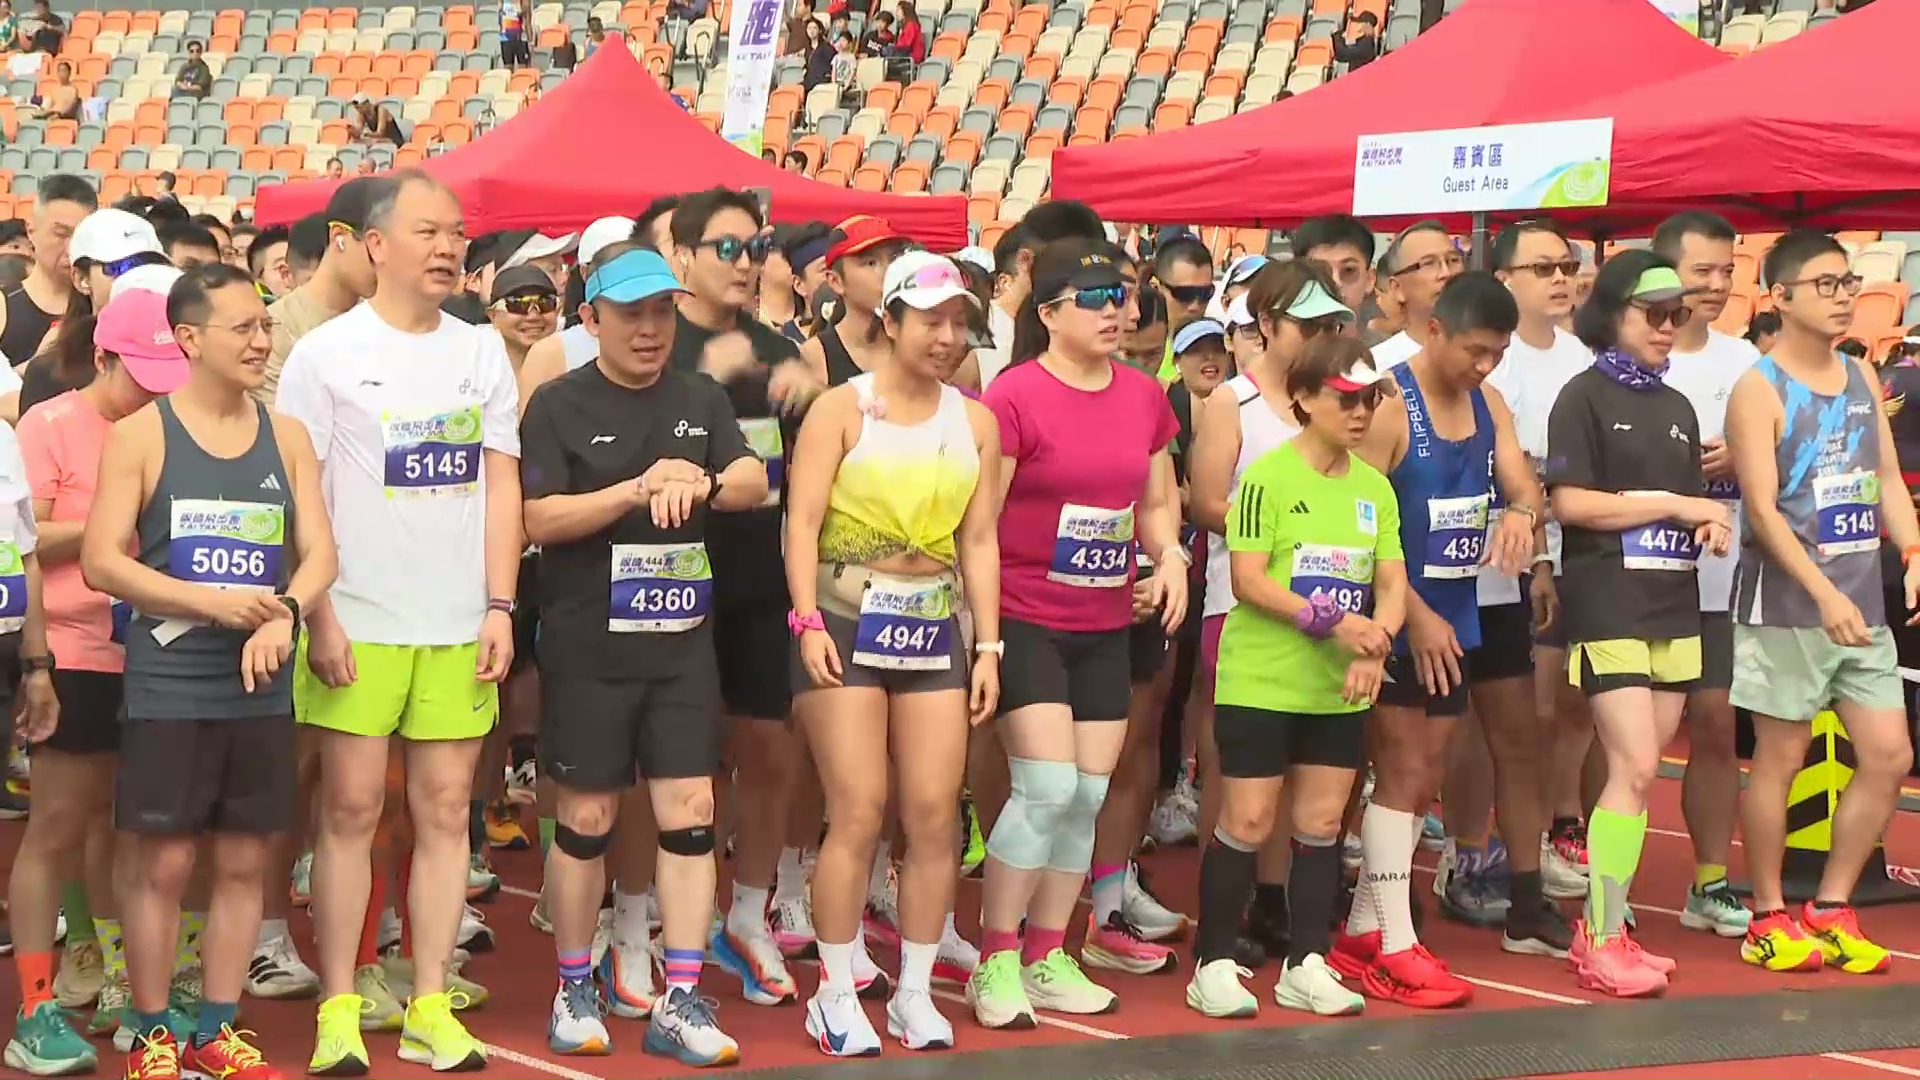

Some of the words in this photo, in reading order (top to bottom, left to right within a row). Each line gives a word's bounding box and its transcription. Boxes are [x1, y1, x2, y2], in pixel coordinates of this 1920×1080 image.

[1453, 143, 1503, 169] 嘉賓區
[1443, 176, 1476, 193] Guest
[1481, 175, 1508, 191] Area
[1406, 387, 1431, 458] FLIPBELT
[405, 450, 468, 479] 5145
[1639, 528, 1691, 552] 4472
[191, 547, 265, 577] 5056
[1070, 545, 1128, 570] 4334
[630, 586, 696, 612] 4360
[875, 624, 940, 651] 4947
